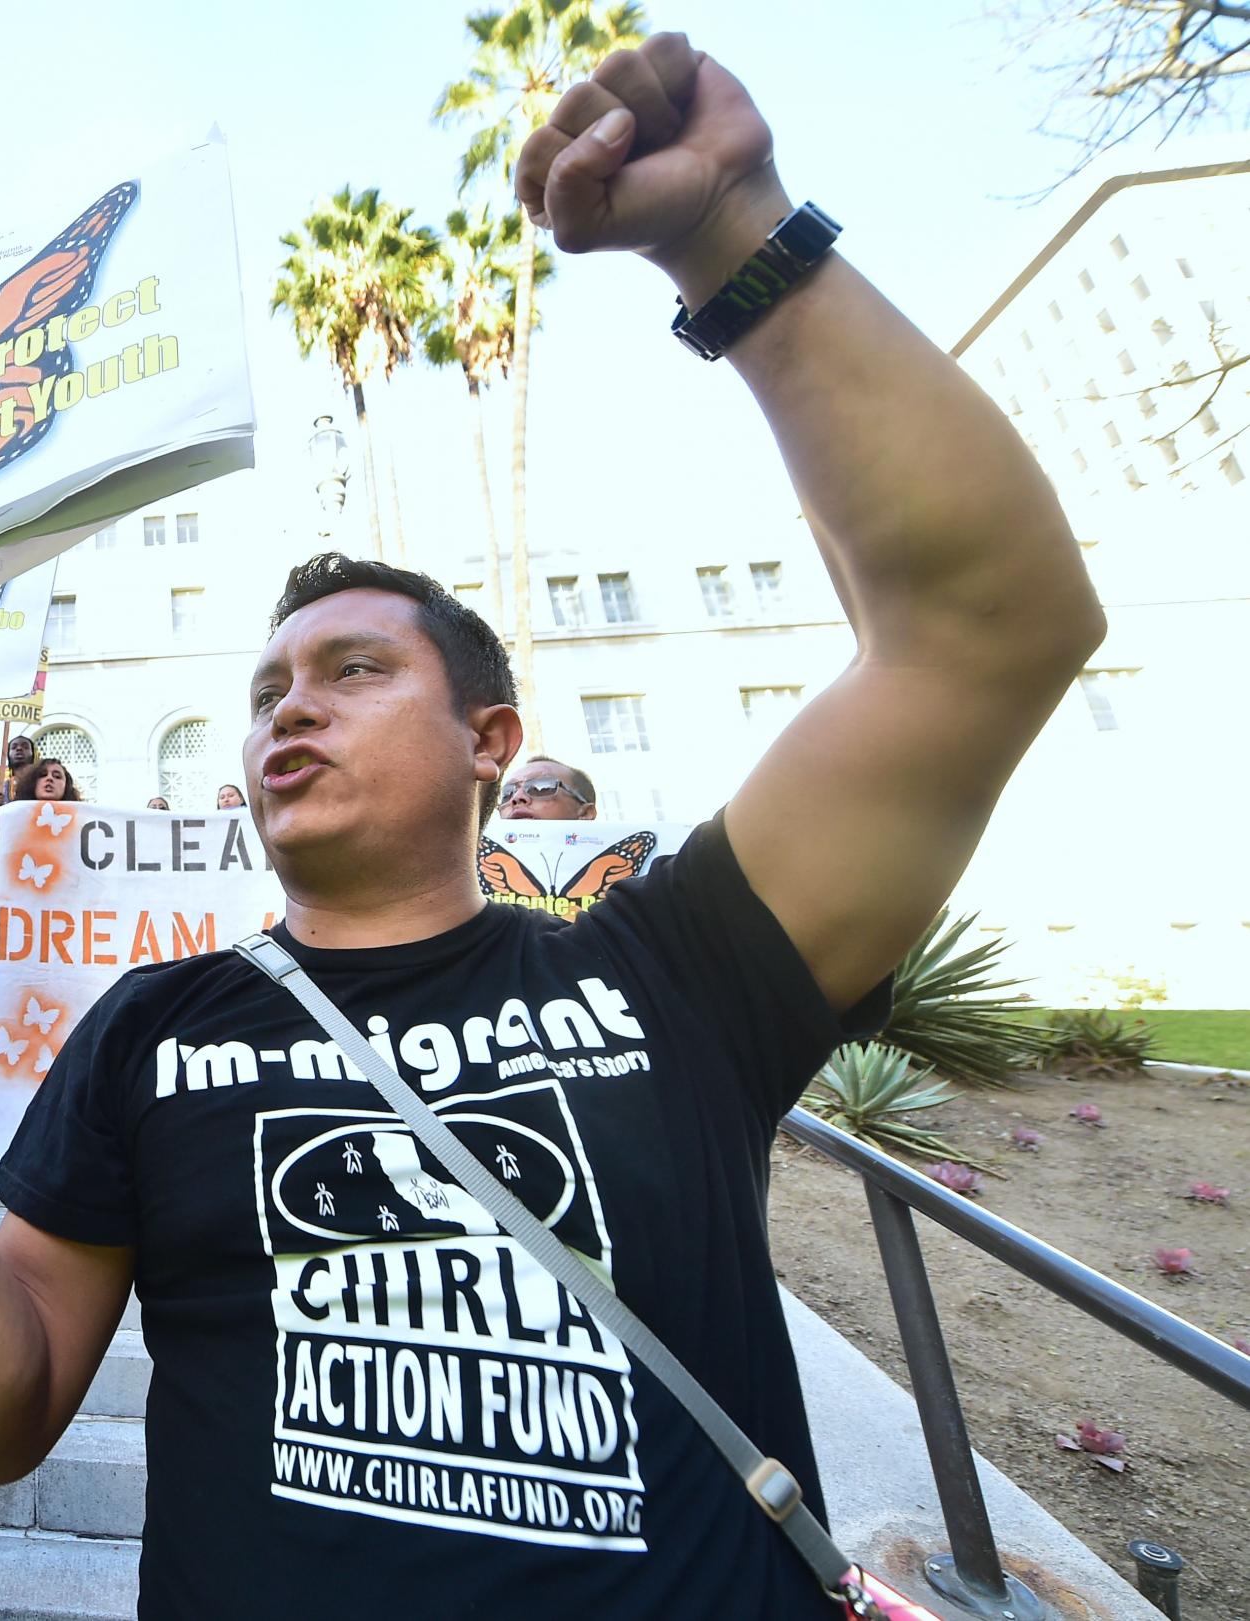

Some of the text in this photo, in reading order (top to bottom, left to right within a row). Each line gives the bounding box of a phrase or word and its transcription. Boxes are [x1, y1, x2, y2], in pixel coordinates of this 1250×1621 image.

[26, 334, 180, 426] Youth
[80, 818, 274, 872] CLEA
[497, 1049, 652, 1080] Ameca's Story
[290, 1246, 608, 1357] CHIRLA
[288, 1339, 619, 1463] ACTION FUND
[272, 1440, 645, 1534] WWW.CHIRLAFUND.ORG
